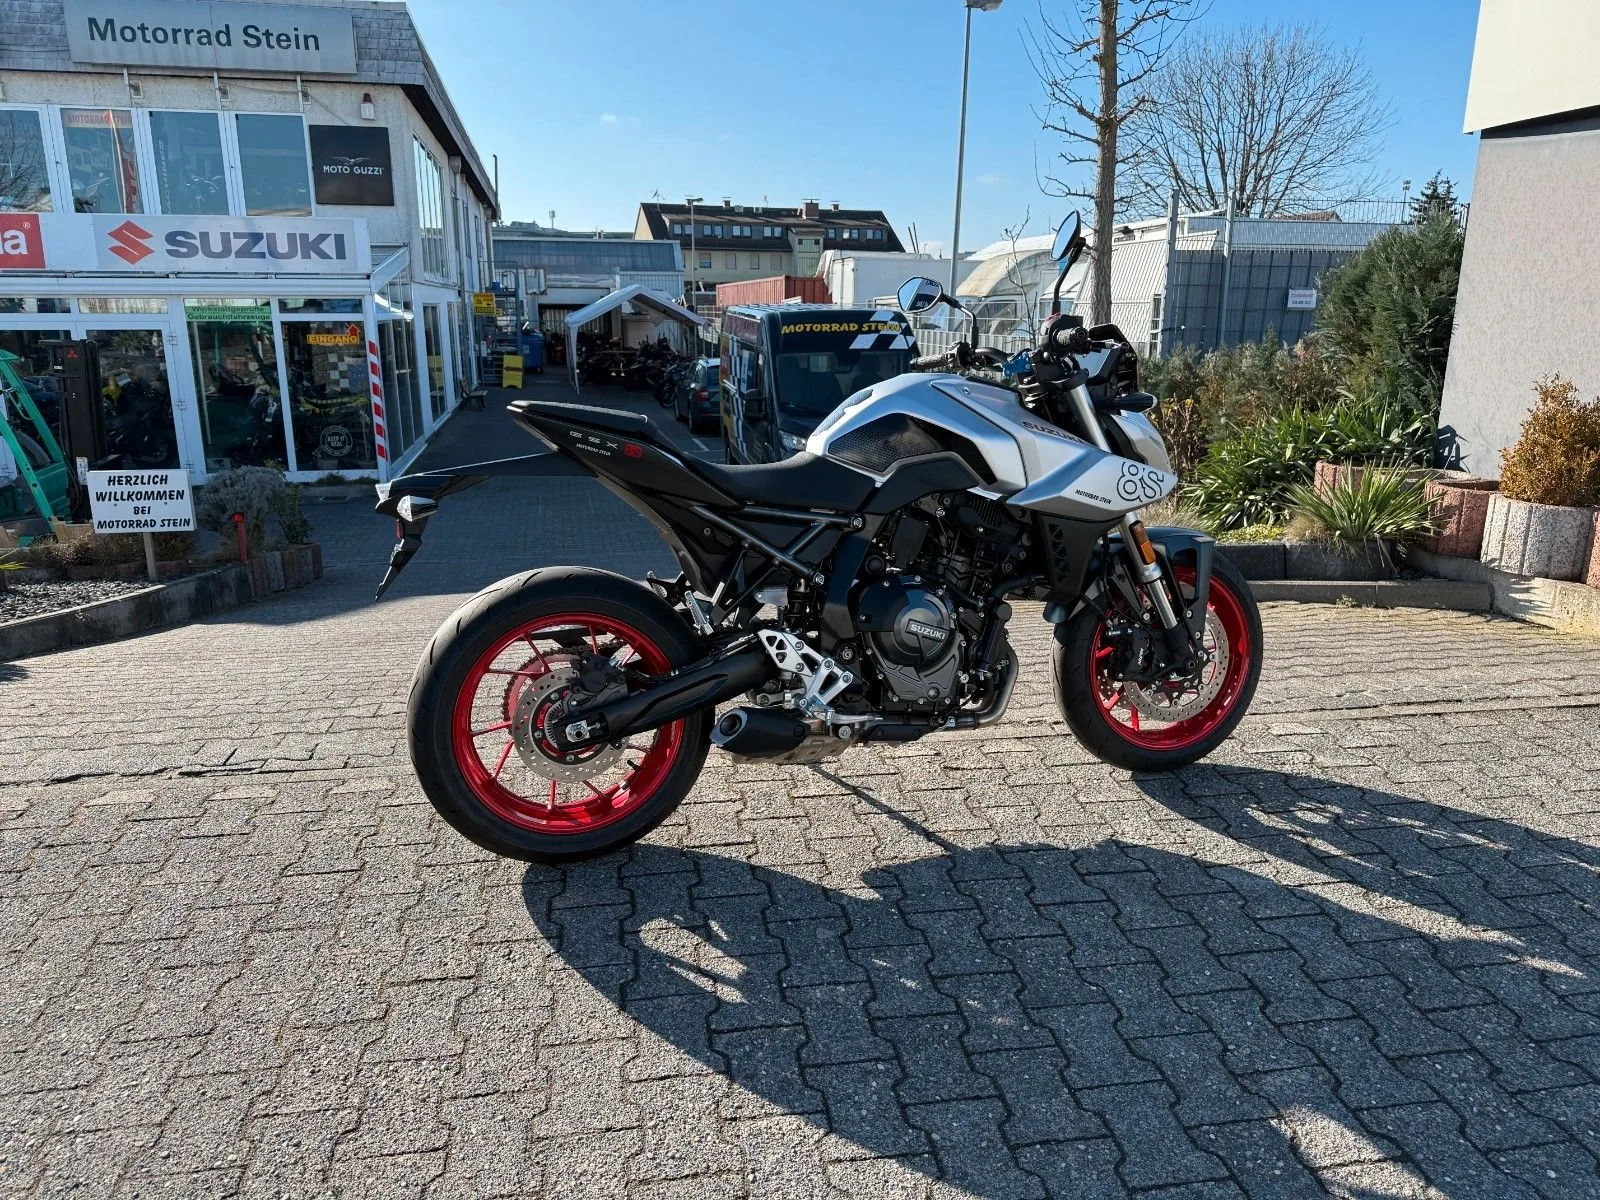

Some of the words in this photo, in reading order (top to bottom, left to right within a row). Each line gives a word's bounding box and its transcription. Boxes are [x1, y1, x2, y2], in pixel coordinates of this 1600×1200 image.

[87, 17, 232, 47] Motorrad
[242, 24, 320, 51] Stein
[323, 165, 350, 174] MOTO
[353, 166, 383, 175] GUZZI
[164, 230, 347, 260] SUZUKI
[781, 323, 859, 334] MOTORRAD
[861, 322, 902, 333] STEIN
[309, 335, 358, 343] EINGANG
[107, 474, 168, 487] HERZLICH
[95, 489, 185, 502] WILLKOMMEN
[133, 506, 151, 515] BEI
[97, 519, 157, 529] MOTORRAD
[160, 517, 191, 528] STEIN
[910, 623, 946, 640] SUZUKI
